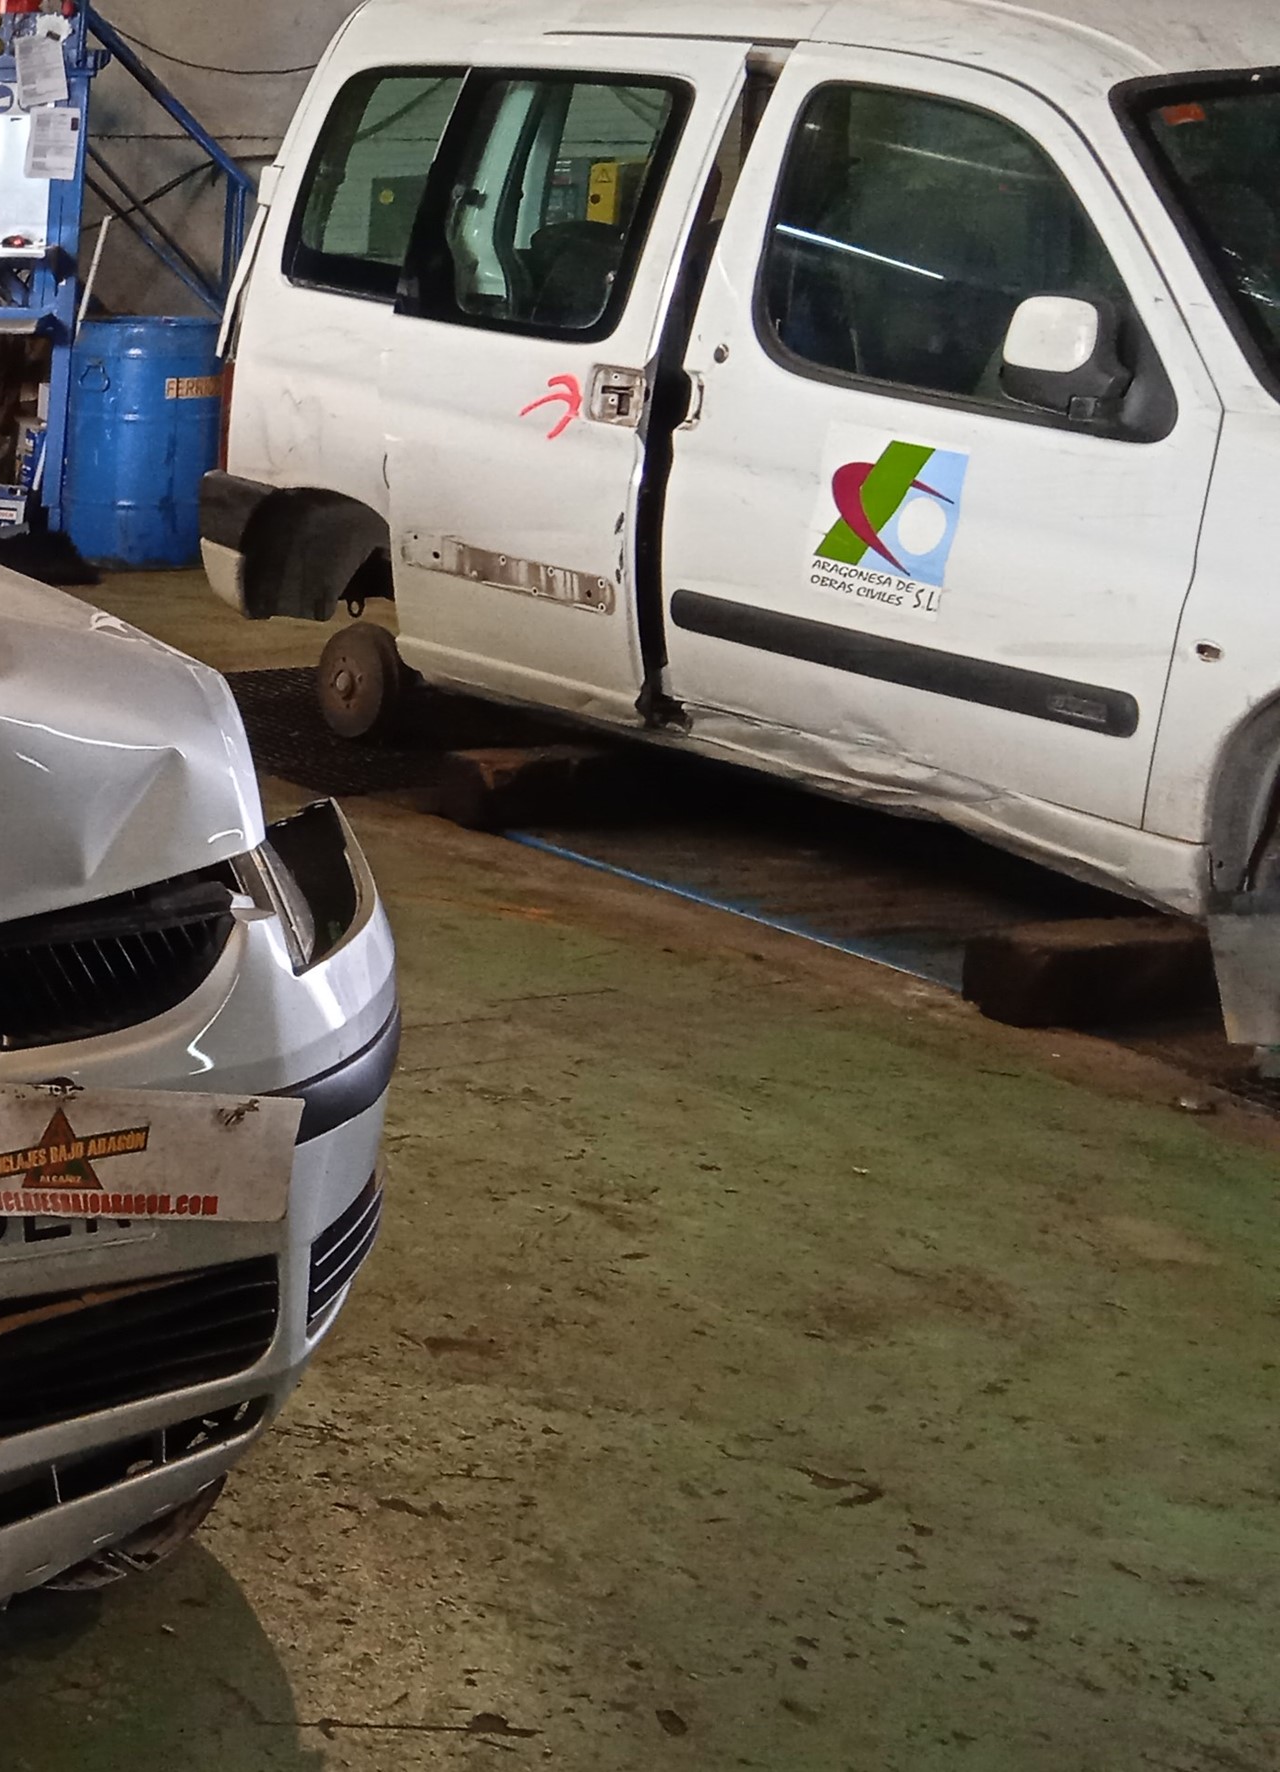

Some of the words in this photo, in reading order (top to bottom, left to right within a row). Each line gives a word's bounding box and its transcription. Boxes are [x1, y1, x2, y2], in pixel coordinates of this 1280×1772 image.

[810, 574, 854, 594] OBRAS
[855, 585, 904, 607] CIVILES
[811, 559, 892, 587] ARAGONESA
[895, 579, 917, 594] DE
[50, 1141, 84, 1165] BAJO
